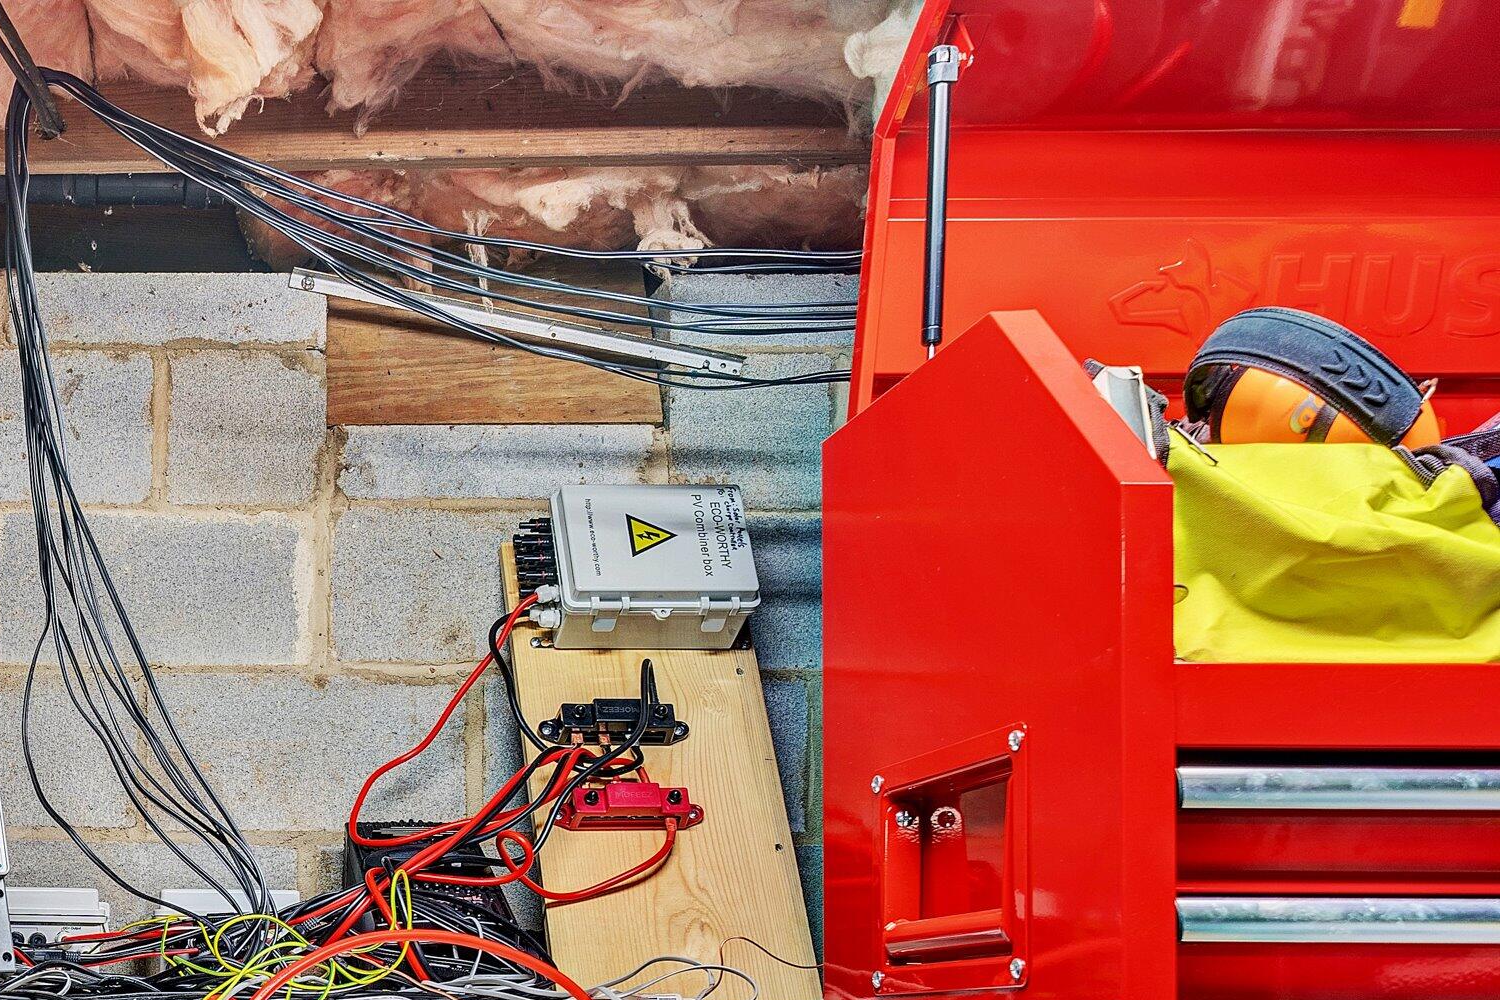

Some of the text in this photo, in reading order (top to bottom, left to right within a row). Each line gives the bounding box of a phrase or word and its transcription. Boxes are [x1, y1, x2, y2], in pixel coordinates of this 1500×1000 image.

[691, 494, 714, 577] PV Combiner box
[709, 501, 733, 569] ECO-WORTHY
